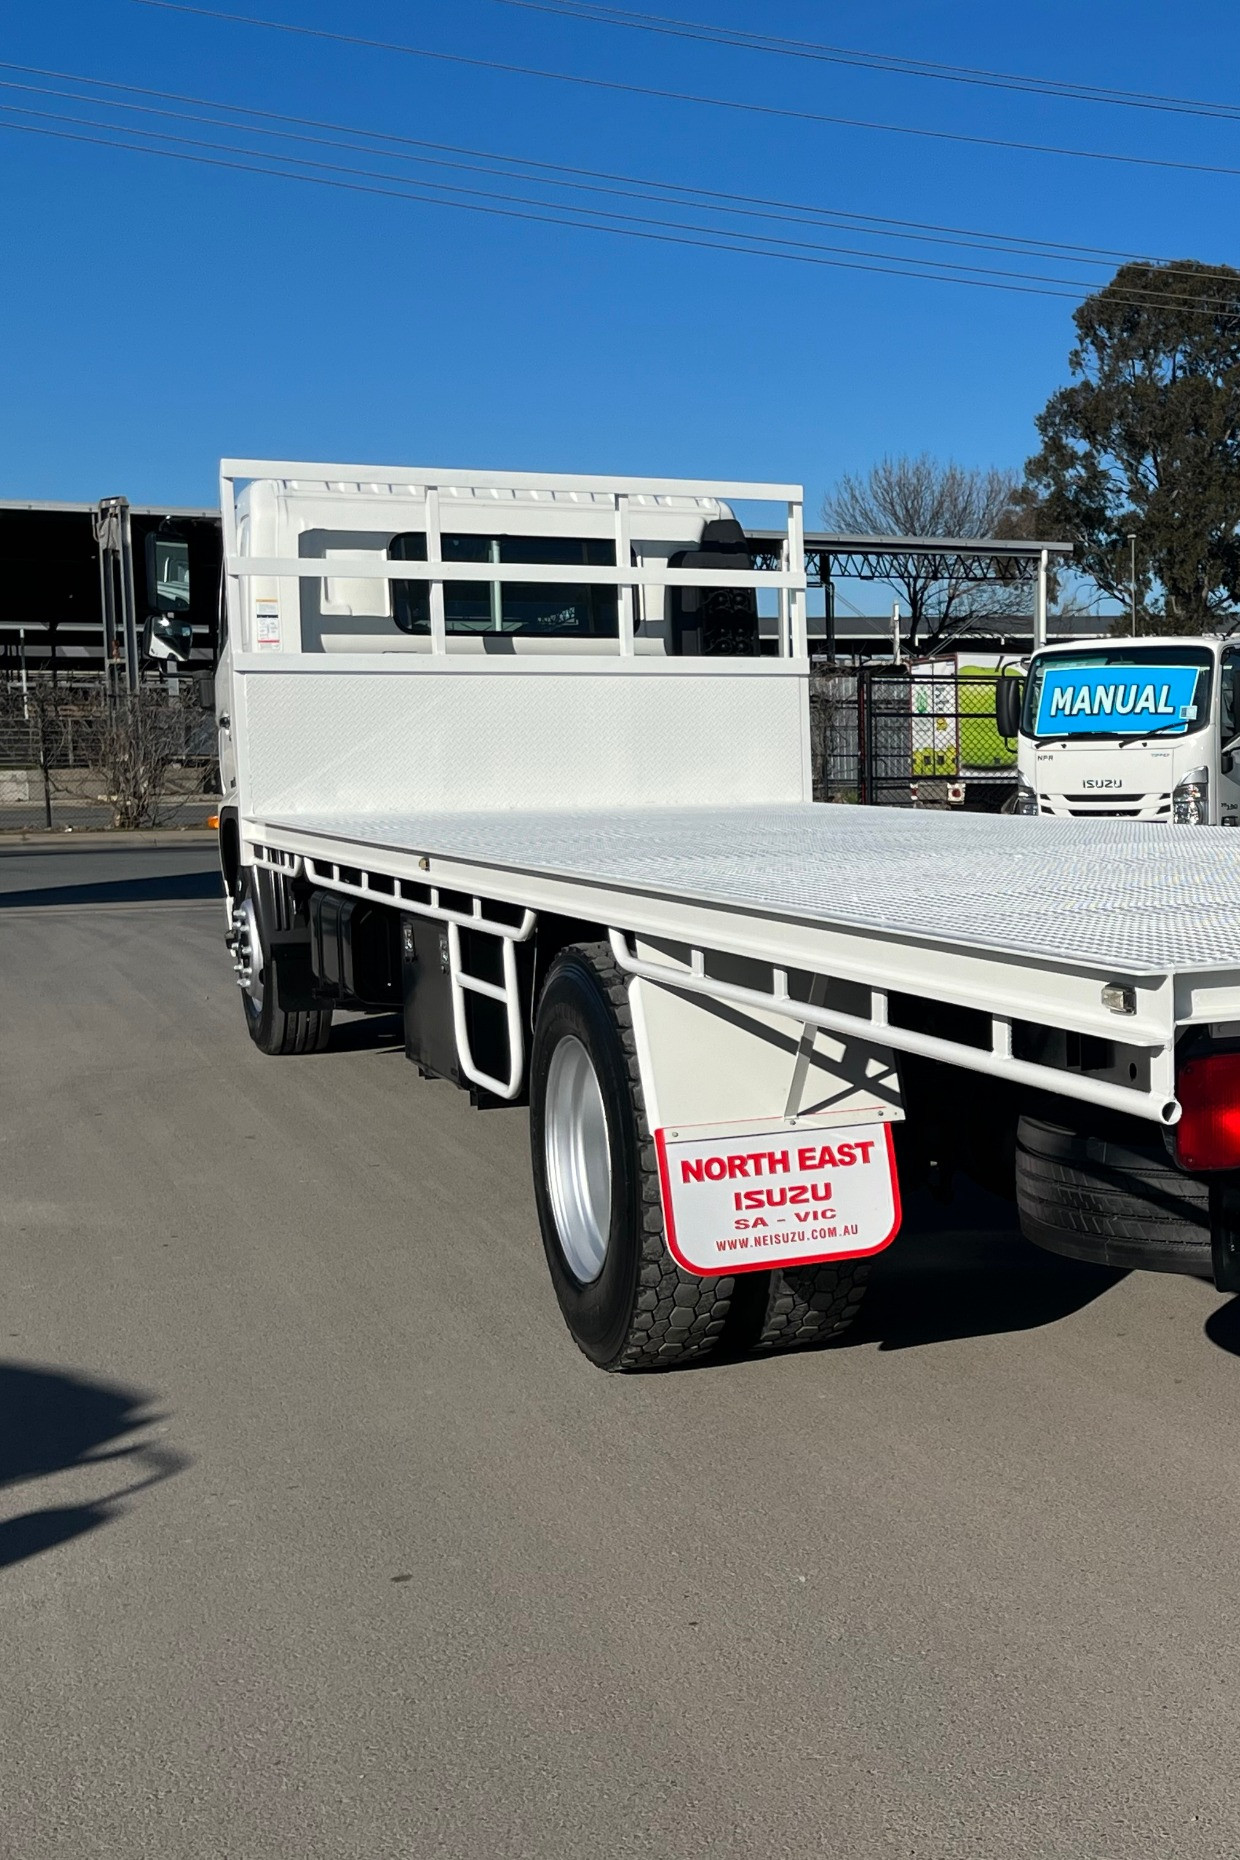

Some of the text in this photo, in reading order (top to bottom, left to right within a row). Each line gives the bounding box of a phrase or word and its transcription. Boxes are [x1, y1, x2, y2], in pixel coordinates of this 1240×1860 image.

[1050, 684, 1175, 717] MANUAL
[1082, 779, 1122, 788] ISUZU
[681, 1141, 875, 1183] NORTH EAST
[734, 1182, 833, 1211] ISUZU
[734, 1217, 768, 1230] SA
[794, 1208, 837, 1222] VIC
[716, 1224, 859, 1252] WWW.NEISUZU.COM.AU
